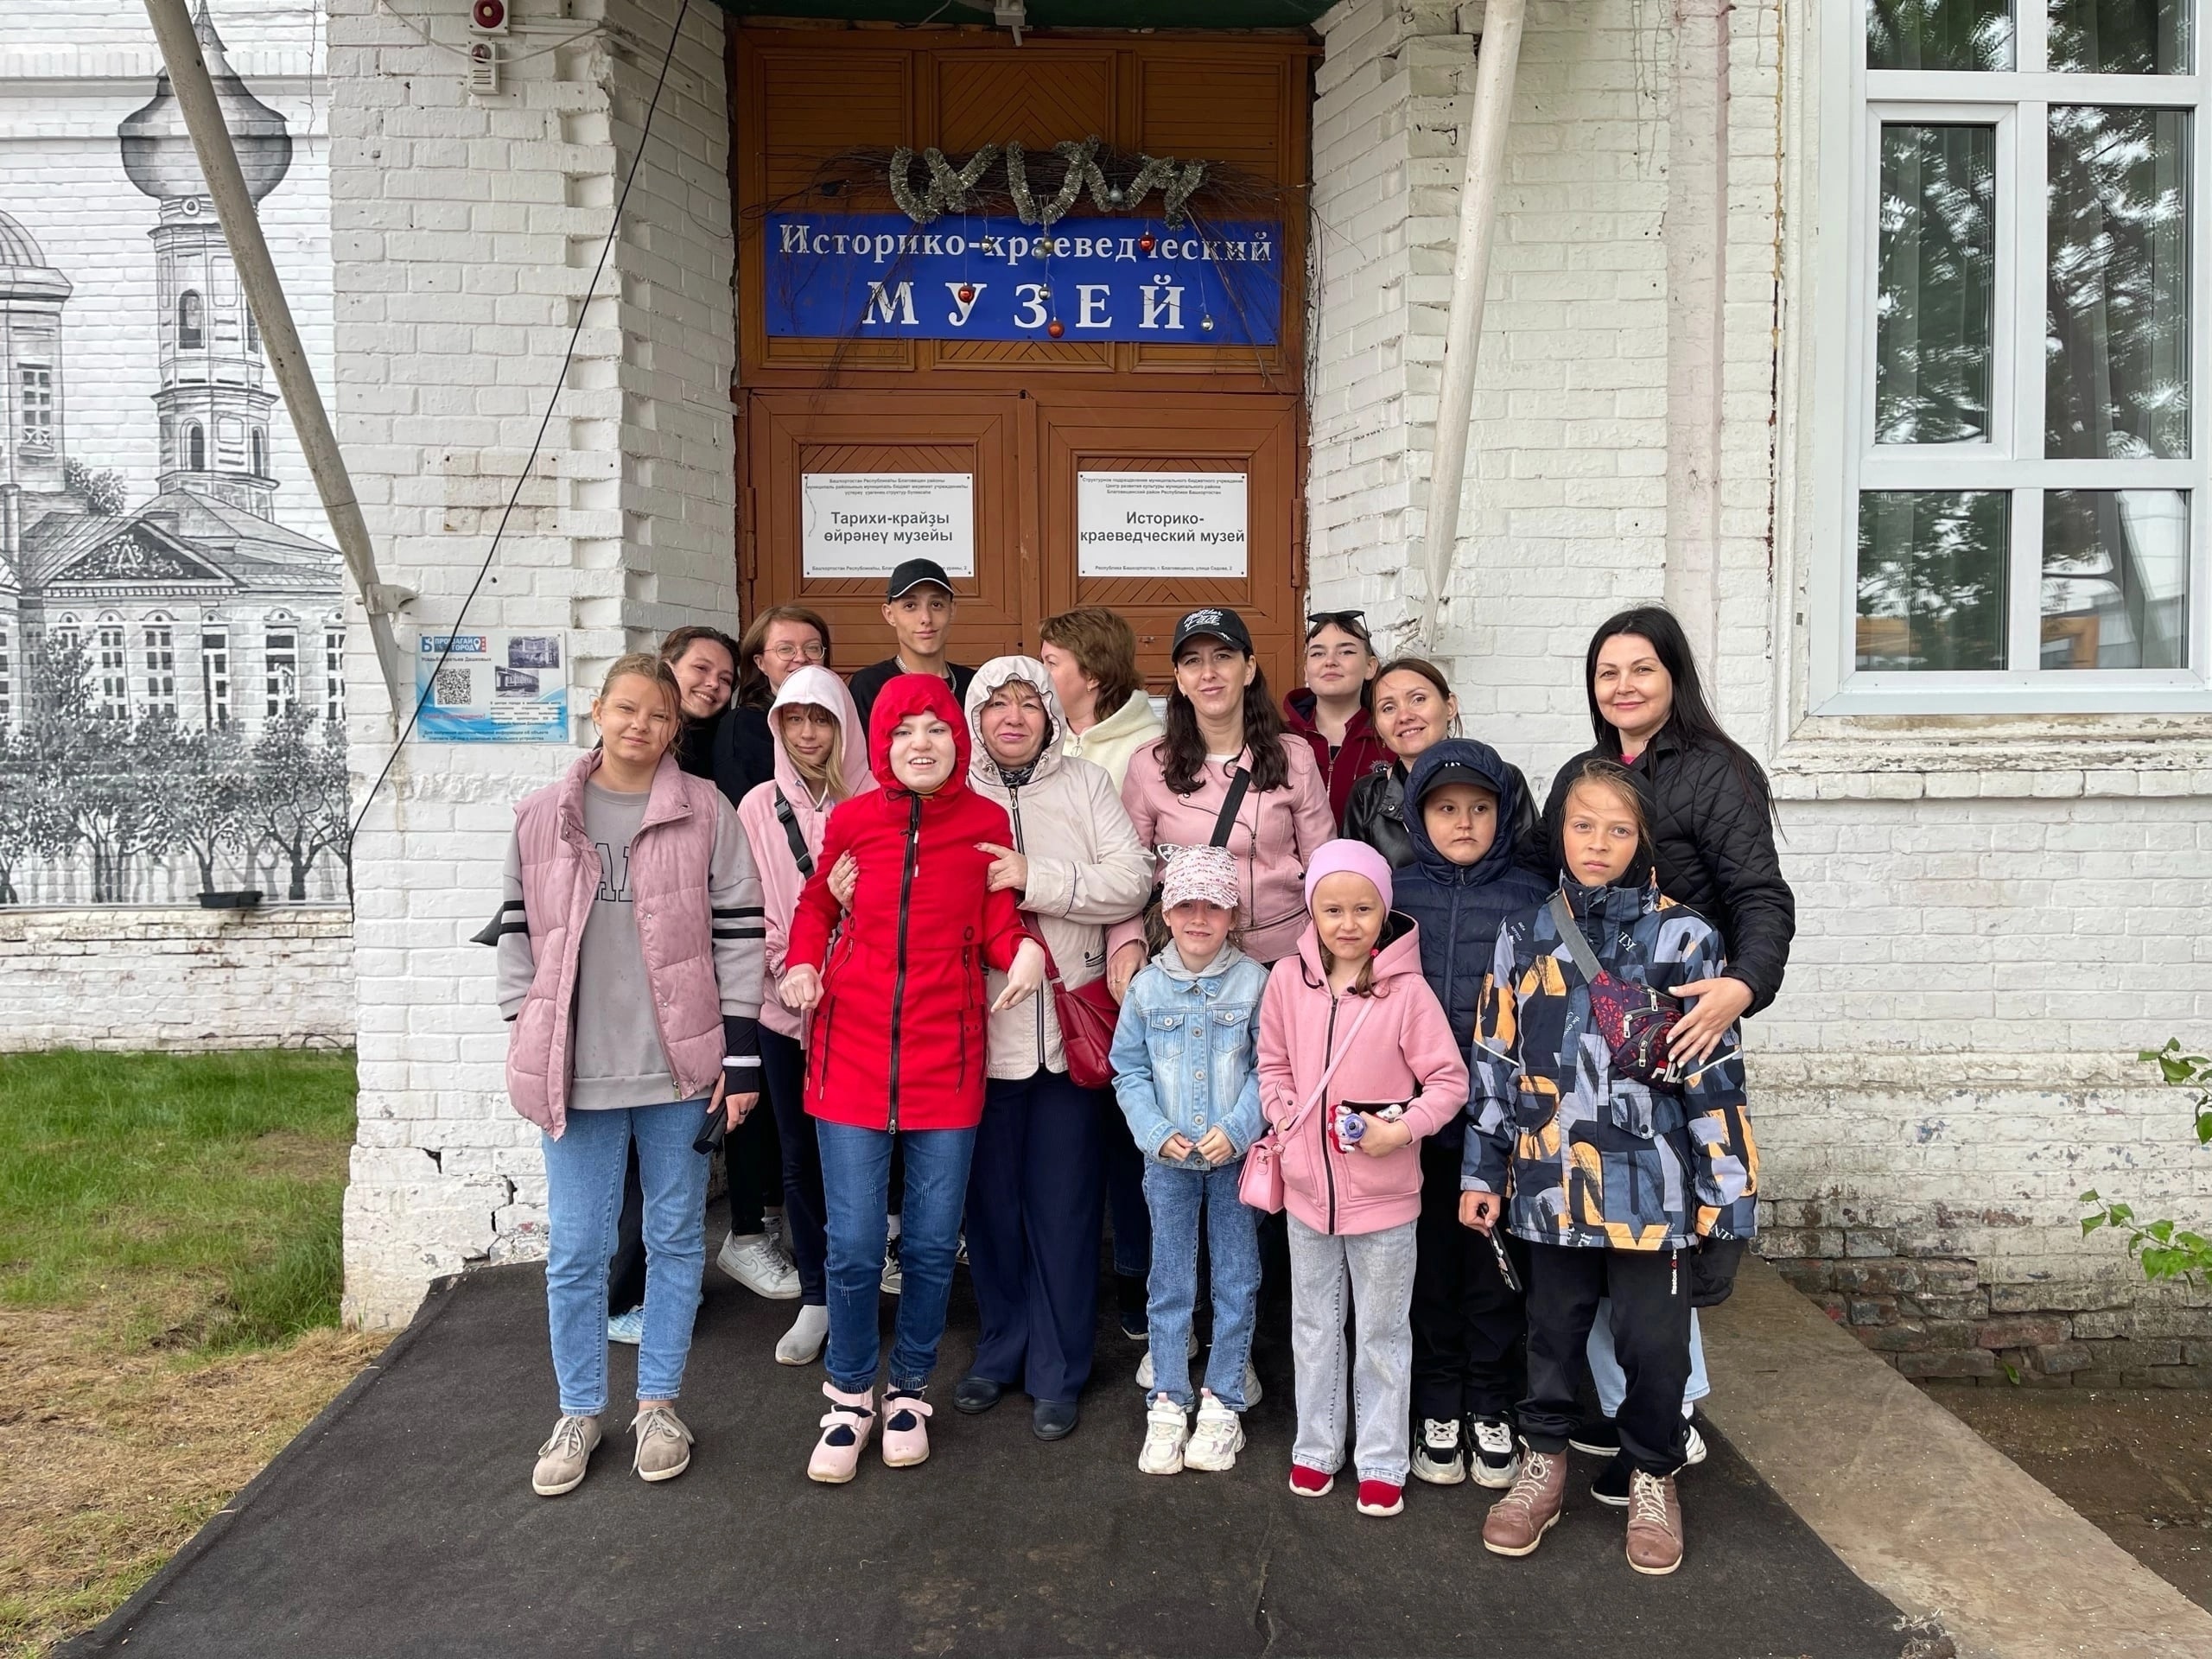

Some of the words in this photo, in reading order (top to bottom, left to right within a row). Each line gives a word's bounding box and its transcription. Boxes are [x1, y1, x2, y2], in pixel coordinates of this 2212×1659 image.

[862, 275, 1185, 328] МУЗЕЙ
[831, 512, 950, 527] Тарихи-крайҙы
[1126, 512, 1205, 527] Историко-
[823, 529, 888, 544] өйрәнеү
[893, 529, 953, 544] музейы
[1080, 530, 1196, 544] краеведческий
[1200, 530, 1245, 544] музей
